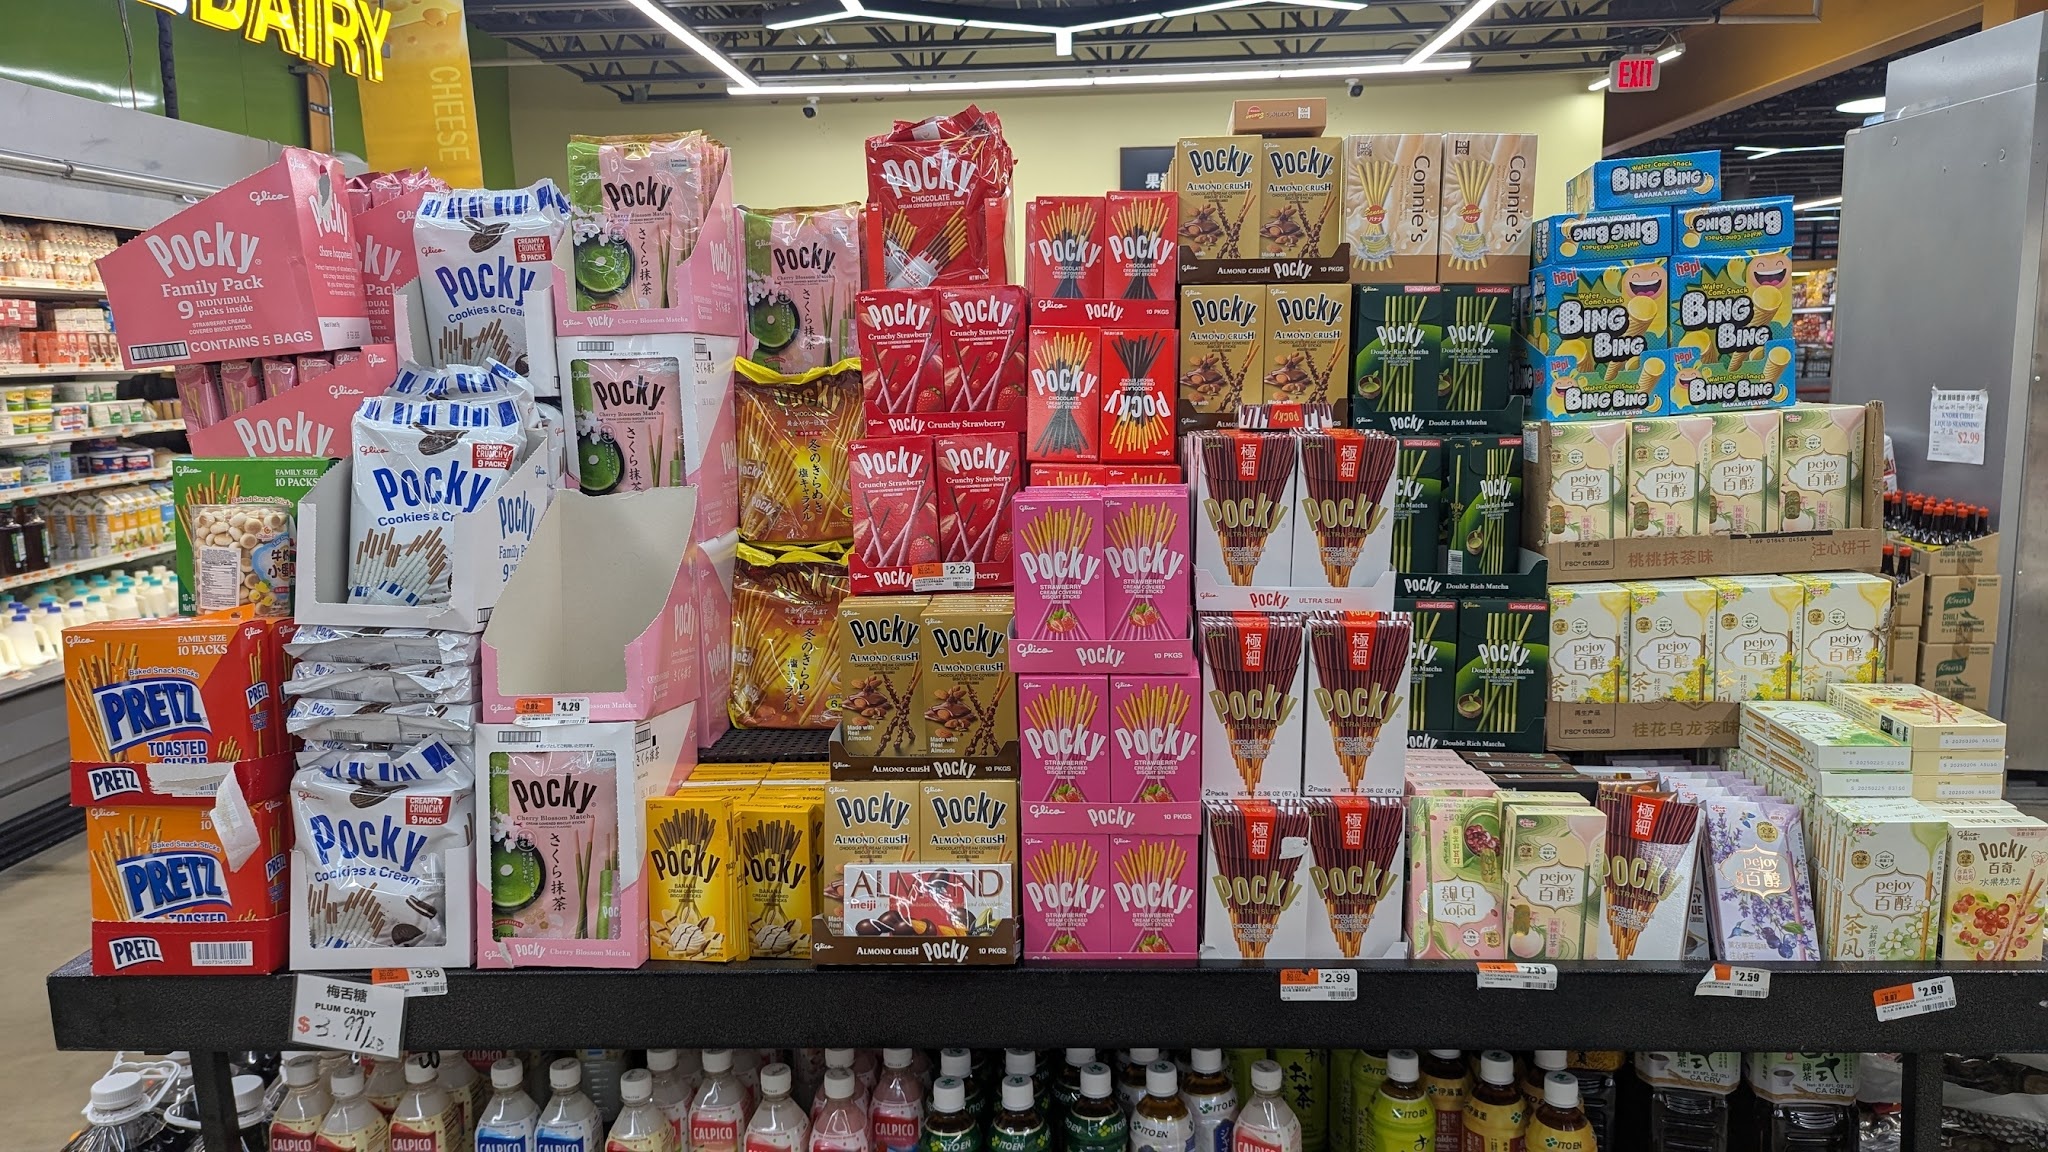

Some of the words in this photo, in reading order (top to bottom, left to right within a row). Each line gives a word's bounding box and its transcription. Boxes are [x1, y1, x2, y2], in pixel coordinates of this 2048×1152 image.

[192, 0, 392, 83] DAIRY
[1618, 60, 1654, 88] EXIT
[429, 66, 471, 162] CHEESE
[1188, 144, 1253, 178] Pocky
[1270, 144, 1333, 178] Pocky
[604, 176, 673, 212] Pocky
[911, 194, 950, 203] CHOCOLATE
[1410, 154, 1431, 243] Connie's
[1505, 154, 1527, 243] Connie's
[145, 222, 260, 278] Pocky
[518, 244, 545, 252] CRUNCHY
[1038, 232, 1102, 267] Pocky
[1108, 232, 1175, 265] Pocky
[638, 228, 652, 296] さくら抹茶
[773, 242, 836, 275] Pocky
[1554, 269, 1578, 286] hapi
[1676, 260, 1700, 278] hapi
[161, 280, 218, 298] Family
[222, 275, 264, 291] Pack
[435, 256, 536, 308] Pocky
[178, 300, 194, 320] 9
[196, 296, 252, 307] INDIVIDUAL
[1681, 292, 1751, 327] BING
[198, 308, 223, 318] packs
[226, 304, 254, 314] inside
[868, 299, 930, 331] Pocky
[950, 295, 1014, 328] Pocky
[1558, 301, 1626, 335] BING
[191, 336, 260, 352] CONTAINS
[263, 336, 270, 346] 5
[274, 330, 313, 344] BAGS
[868, 332, 895, 340] Crunchy
[896, 331, 932, 340] Strawberry
[950, 329, 976, 337] Crunchy
[978, 328, 1015, 337] Strawberry
[1718, 324, 1771, 349] BING
[1593, 333, 1645, 358] BING
[593, 375, 665, 410] Pocky
[1241, 444, 1257, 476] 極細
[1341, 445, 1357, 478] 極細
[176, 466, 201, 475] Glico
[275, 478, 285, 486] 10
[287, 478, 318, 486] PACKS
[373, 461, 492, 513] Pocky
[859, 480, 887, 489] Crunchy
[889, 479, 926, 488] Strawberry
[1570, 473, 1603, 487] pejoy
[1570, 486, 1603, 502] 百醇
[378, 512, 430, 526] Cookies
[432, 512, 440, 520] &
[1811, 538, 1872, 557] 注心饼干
[1627, 550, 1714, 568] 桃桃抹茶味
[1403, 576, 1442, 595] Pocky
[1946, 596, 1971, 604] Knorr
[65, 635, 95, 646] Glico
[1352, 632, 1370, 666] 極細
[177, 646, 190, 656] 10
[192, 645, 228, 656] PACKS
[850, 653, 888, 662] ALMOND
[890, 652, 919, 661] CRUSH
[1245, 632, 1262, 667] 極細
[153, 667, 175, 675] Snack
[177, 668, 199, 679] Sticks
[100, 683, 201, 743] PRETZ
[557, 701, 580, 711] $4.29
[1631, 720, 1739, 738] 桂花乌龙茶味
[148, 741, 207, 756] TOASTED
[92, 770, 140, 797] PRETZ
[409, 804, 444, 814] CRUNCHY
[411, 815, 418, 825] 9
[419, 815, 443, 825] PACKS
[834, 835, 875, 844] ALMOND
[878, 835, 909, 844] CRUSH
[315, 866, 367, 882] Cookies
[369, 866, 377, 876] &
[379, 866, 420, 886] Cream
[550, 832, 567, 912] さくら抹茶
[1988, 862, 2013, 875] 百奇
[124, 856, 223, 912] PRETZ
[1539, 872, 1575, 886] pejoy
[1876, 880, 1915, 893] pejoy
[1978, 877, 2022, 887] 水果粒粒
[1539, 887, 1575, 902] 百醇
[1875, 895, 1913, 911] 百醇
[851, 901, 876, 911] meiji
[112, 940, 162, 965] PRETZ
[515, 942, 546, 959] Pocky
[550, 948, 573, 957] Cherry
[605, 949, 631, 957] Matcha
[1320, 973, 1350, 982] $2.99
[1735, 970, 1760, 983] $2.59
[326, 984, 368, 1003] 梅舌糖
[1918, 984, 1944, 997] $2.99
[315, 1002, 341, 1012] PLUM
[344, 1007, 376, 1018] CANDY
[1703, 1075, 1721, 1083] CRV
[1403, 1110, 1418, 1119] ITO
[1419, 1108, 1427, 1117] EN
[693, 1127, 733, 1139] CALPICO
[875, 1123, 914, 1136] CALPICO
[272, 1138, 312, 1151] CALPICO
[392, 1138, 431, 1151] CALPICO
[1557, 1141, 1571, 1149] ITO
[1572, 1141, 1582, 1149] EN
